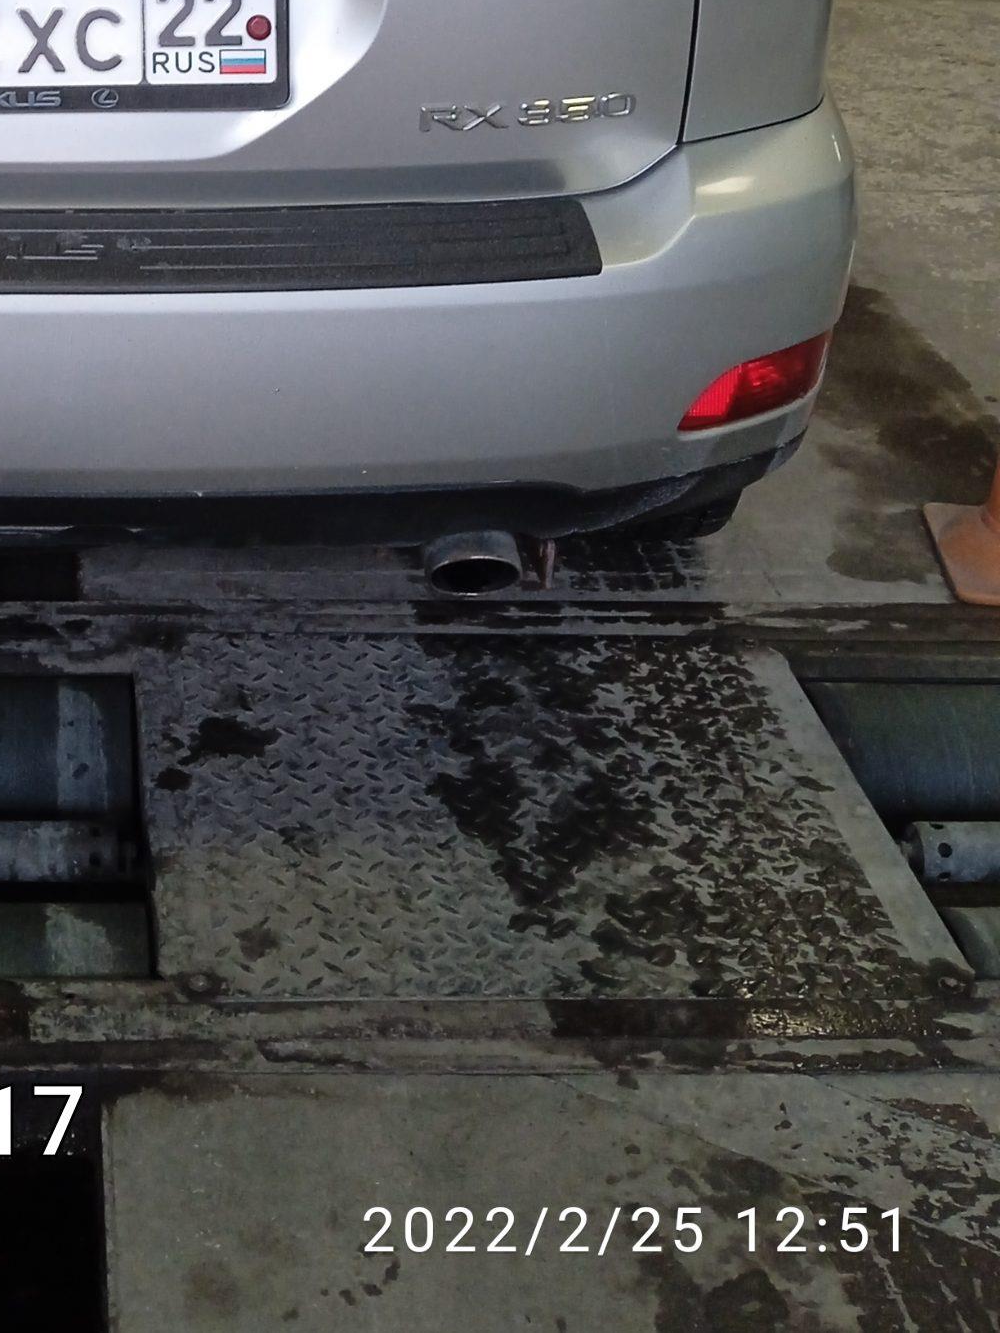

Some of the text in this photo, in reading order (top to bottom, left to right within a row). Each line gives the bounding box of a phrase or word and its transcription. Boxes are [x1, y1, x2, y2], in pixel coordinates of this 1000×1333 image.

[152, 51, 216, 75] RUS
[419, 92, 637, 132] RX 350
